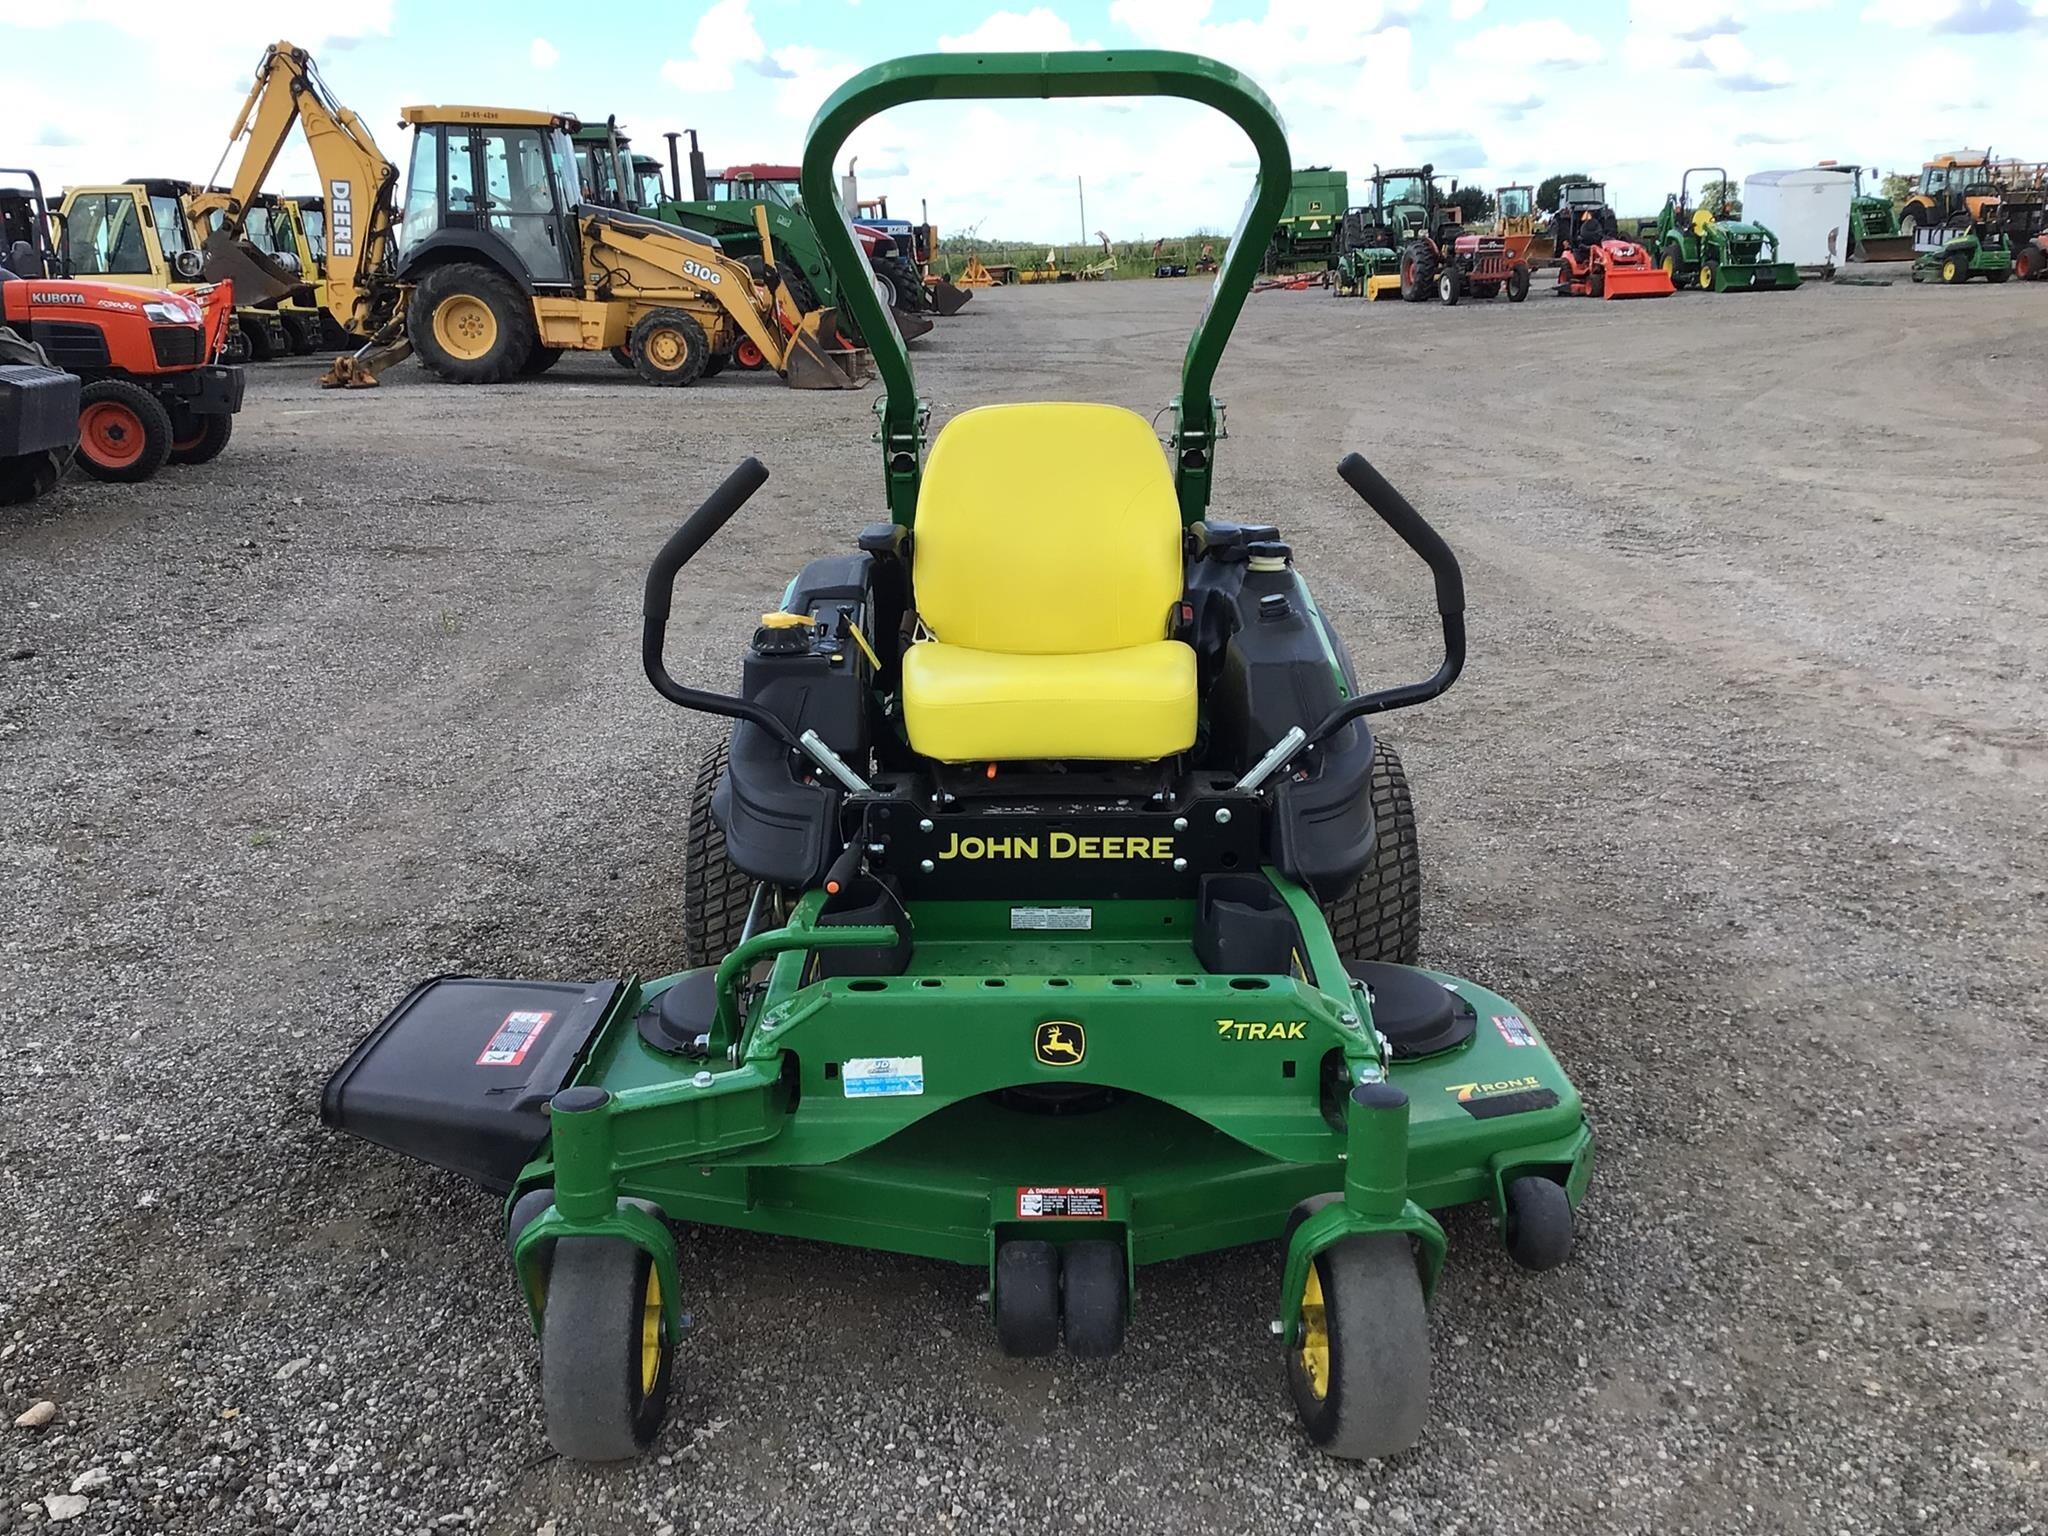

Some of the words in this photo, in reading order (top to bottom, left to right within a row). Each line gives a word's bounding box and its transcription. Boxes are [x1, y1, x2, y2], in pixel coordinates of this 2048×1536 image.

[331, 180, 353, 256] DEERE
[683, 260, 721, 284] 310G
[32, 293, 85, 304] KUBOTA
[938, 832, 1039, 859] JOHN
[1049, 832, 1175, 859] DEERE
